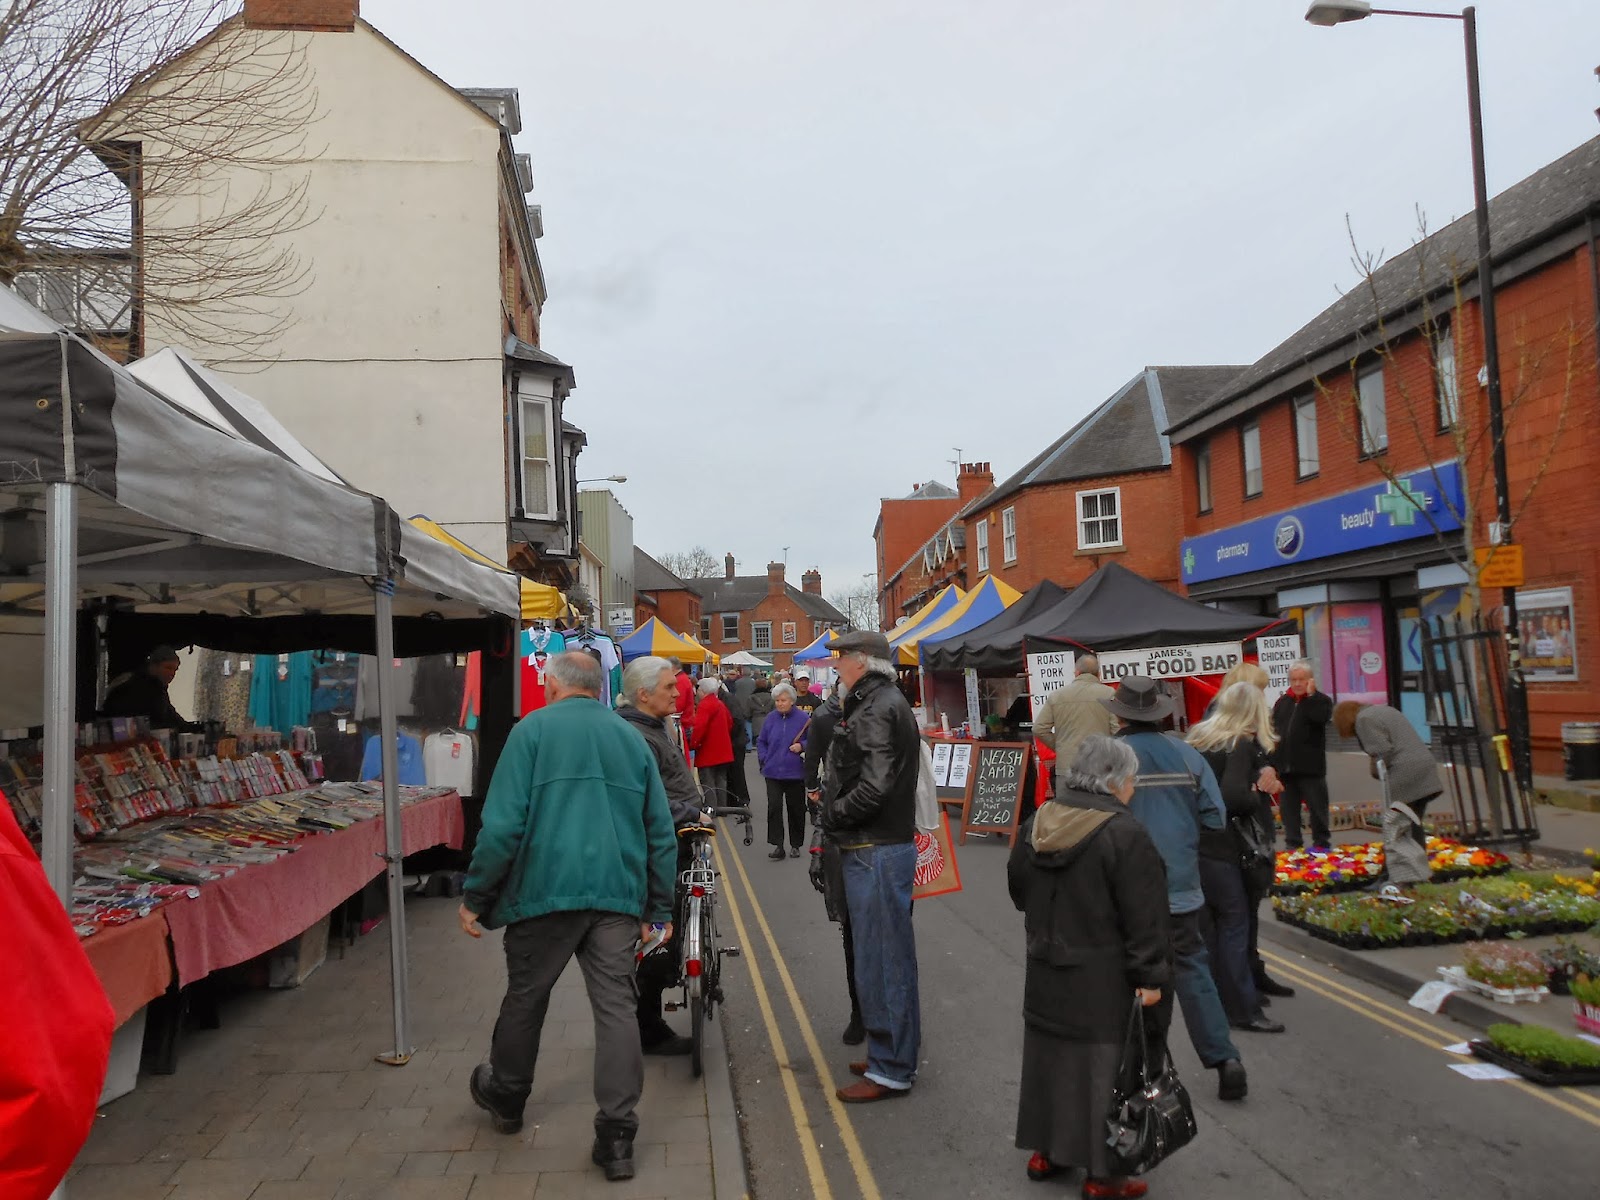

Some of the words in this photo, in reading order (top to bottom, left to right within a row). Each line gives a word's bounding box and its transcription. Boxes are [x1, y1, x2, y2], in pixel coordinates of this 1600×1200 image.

[1342, 508, 1375, 530] beauty
[1217, 541, 1250, 562] pharmacy
[1264, 637, 1290, 648] ROAST
[1037, 654, 1065, 665] ROAST
[1147, 648, 1192, 660] JAMES's
[1261, 651, 1296, 662] CHICKEN
[1040, 667, 1064, 678] PORK
[1101, 661, 1140, 680] HOT
[1145, 657, 1196, 676] FOOD
[1201, 653, 1239, 672] BAR
[1042, 680, 1065, 691] WITH
[981, 749, 1023, 767] WELSH
[979, 765, 1015, 780] LAMB
